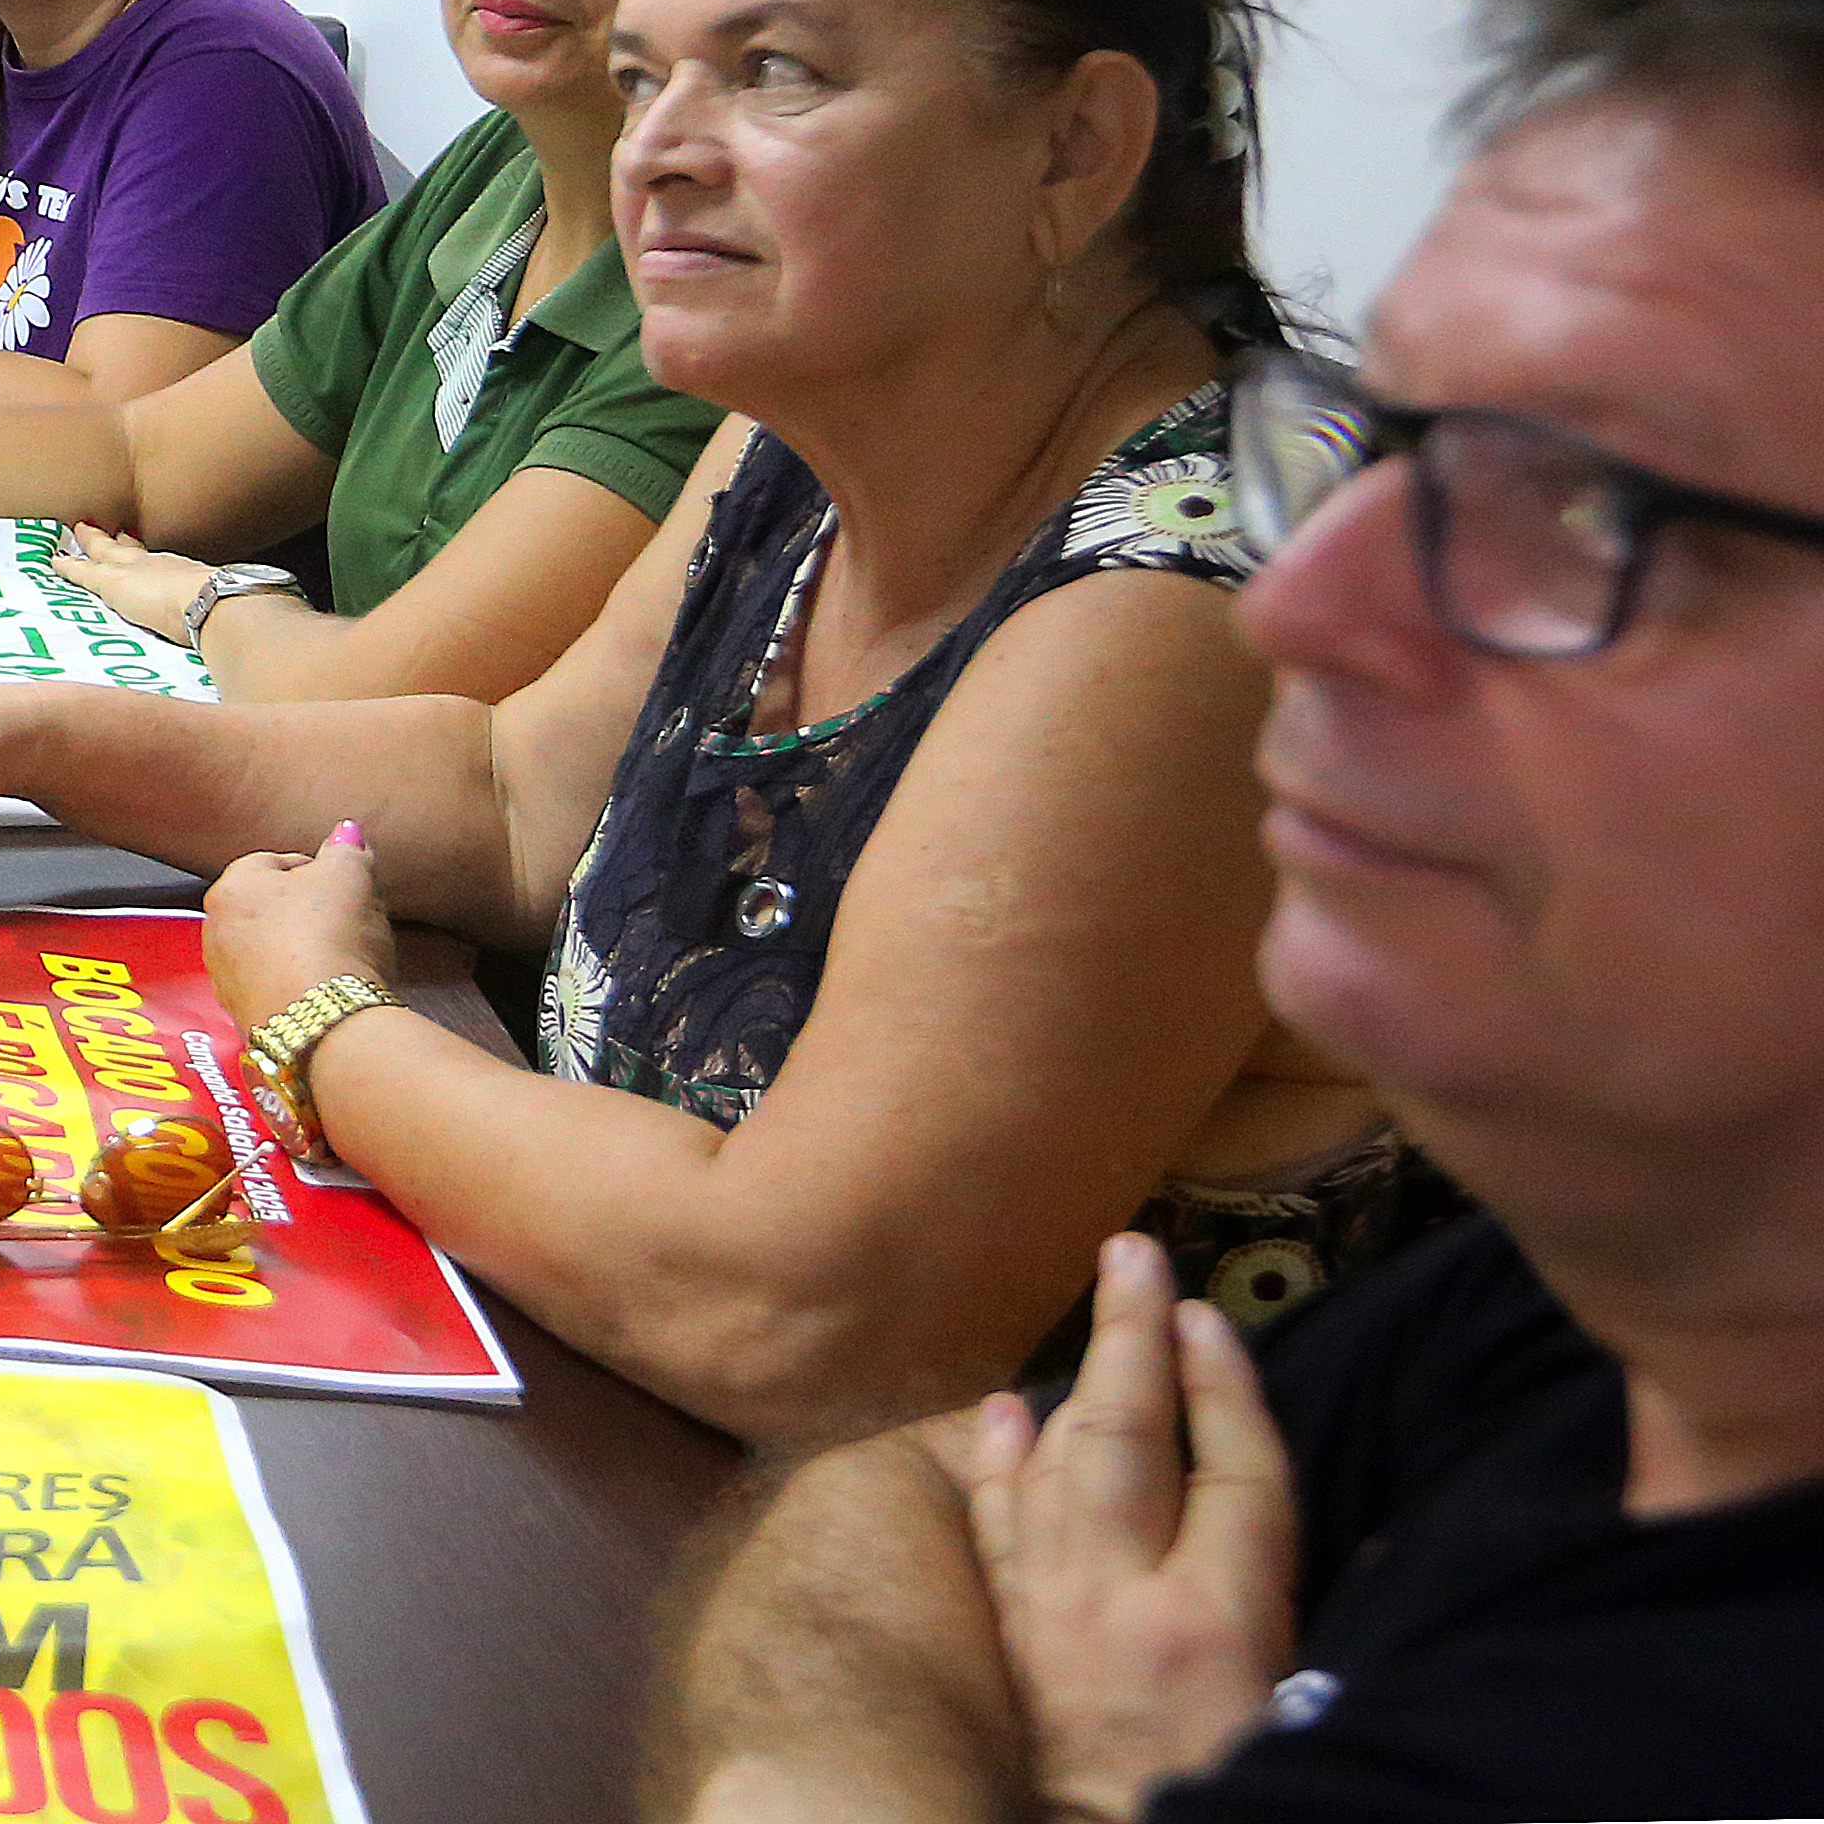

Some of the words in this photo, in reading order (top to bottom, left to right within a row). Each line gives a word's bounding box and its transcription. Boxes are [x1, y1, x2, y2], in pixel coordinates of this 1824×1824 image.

[39, 951, 194, 1102] BOCADO
[180, 1030, 243, 1106] Campanha
[241, 1179, 294, 1223] 2025
